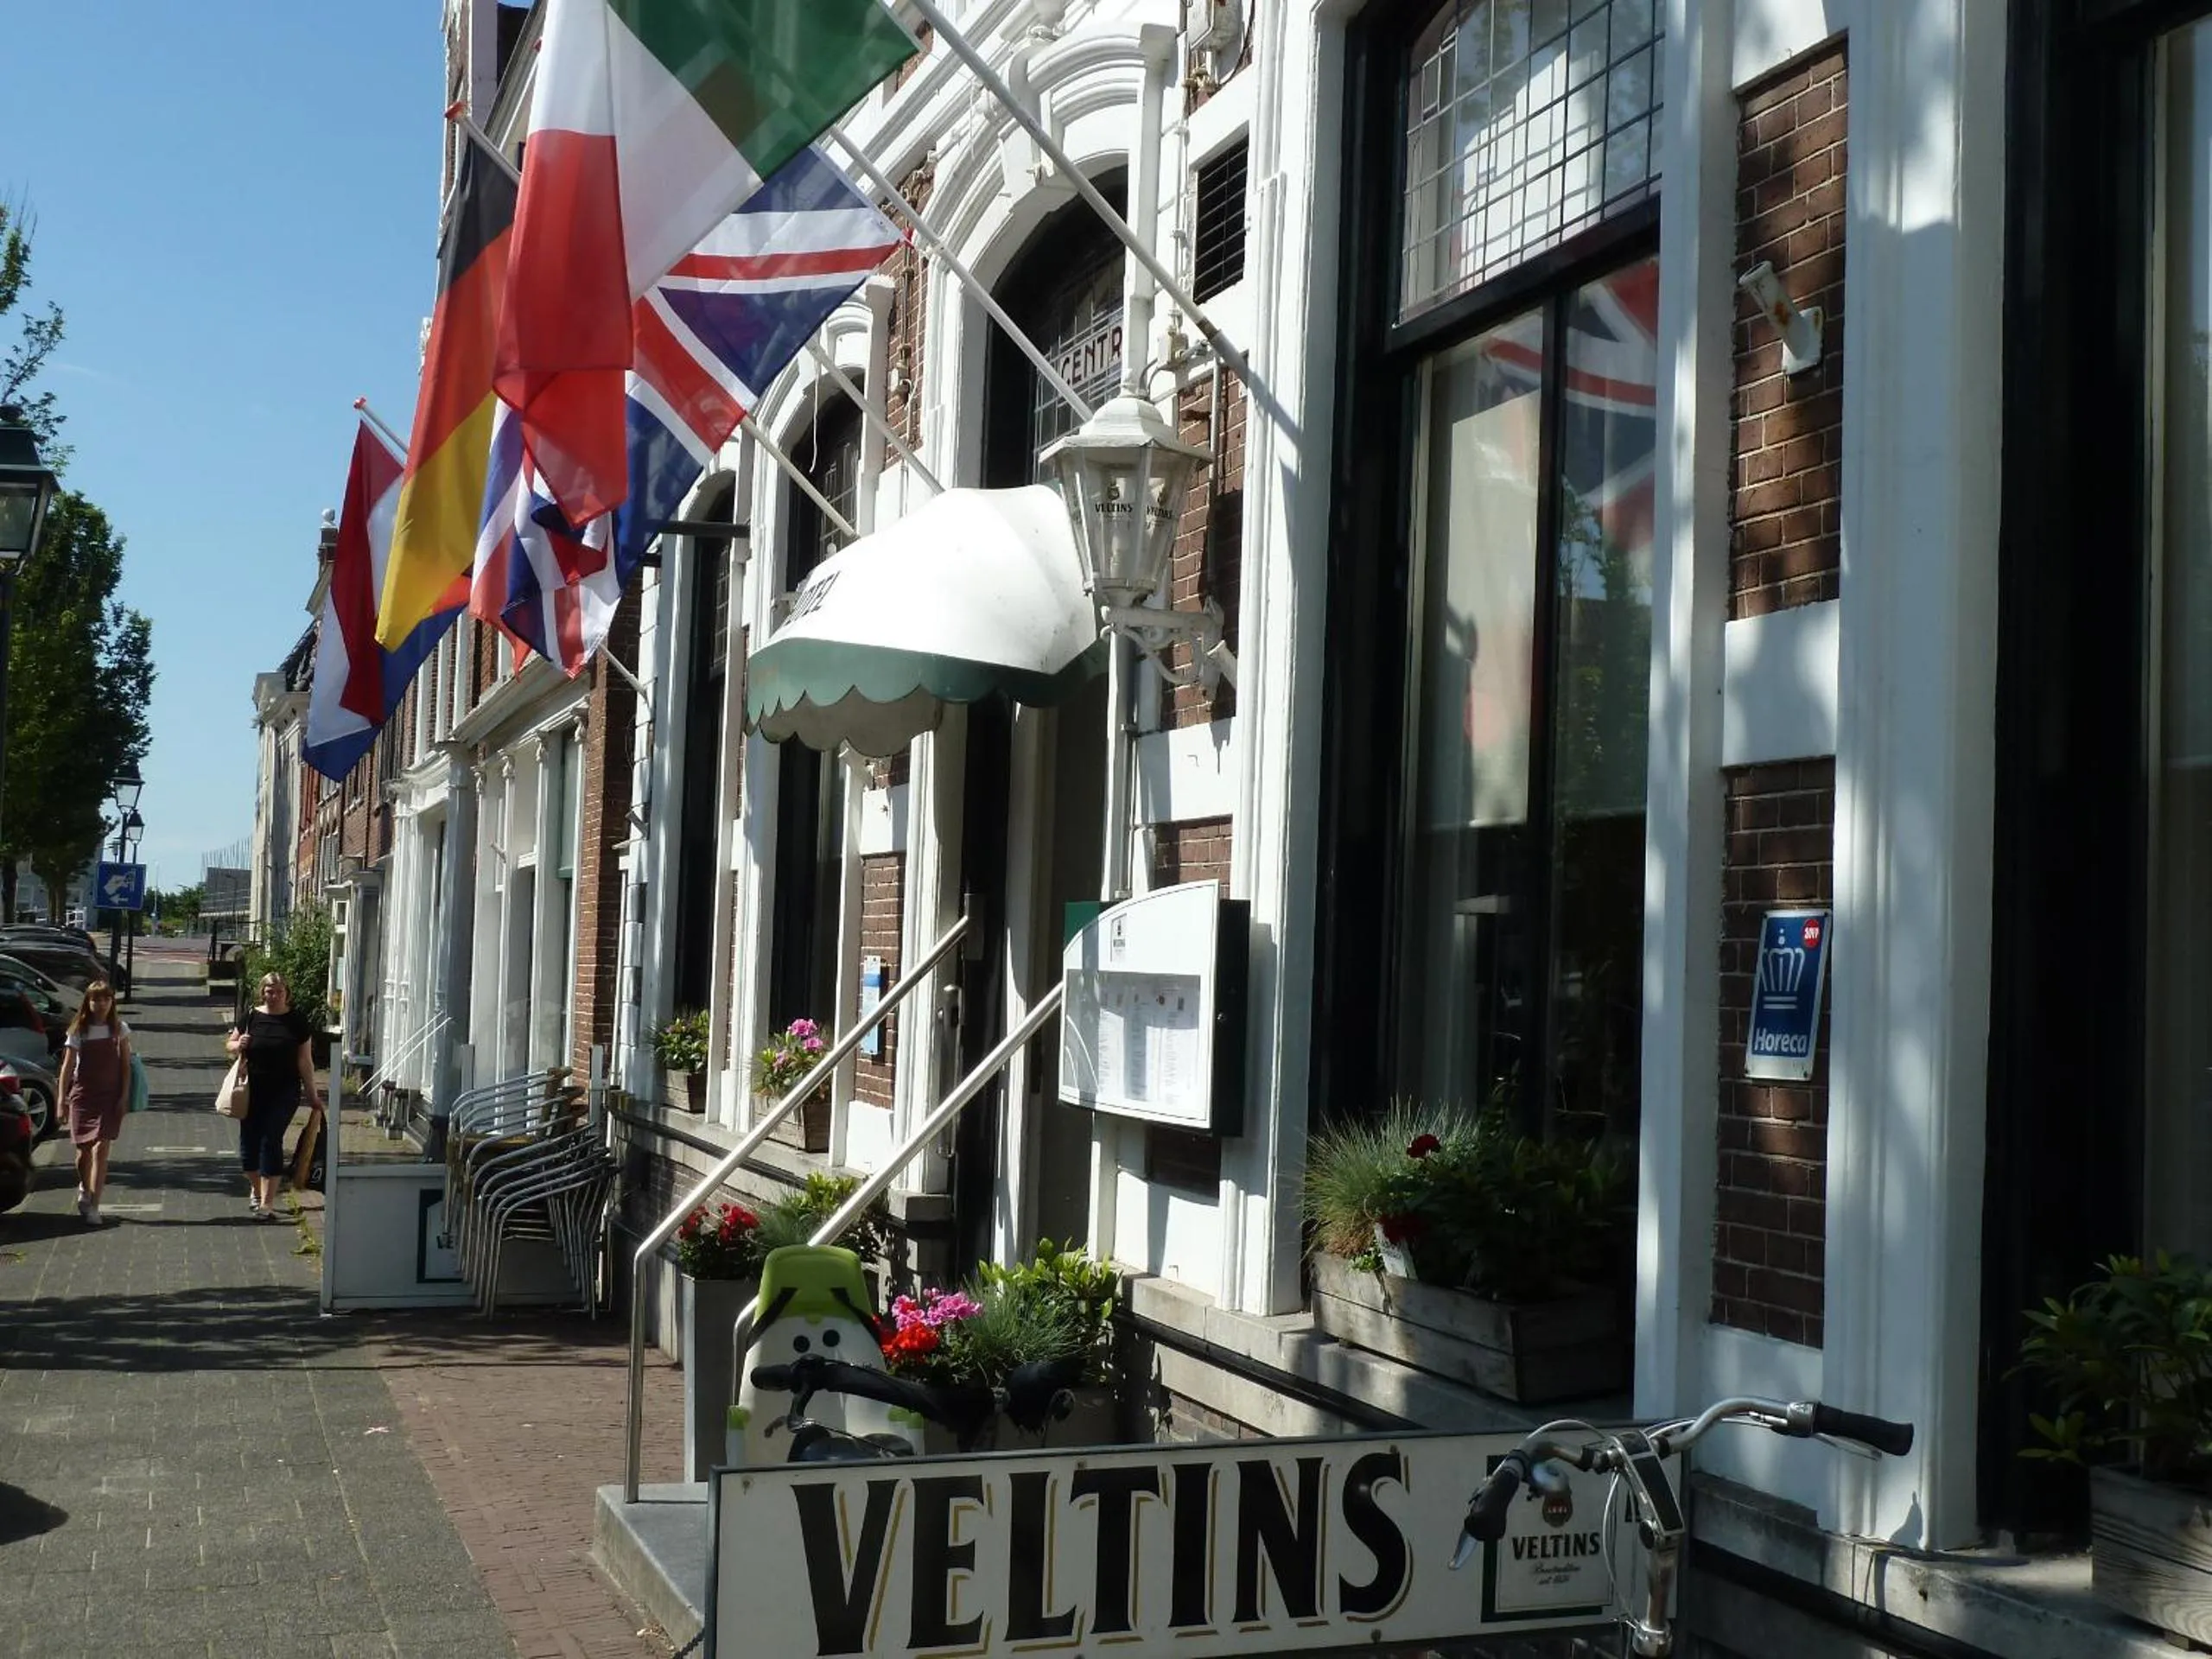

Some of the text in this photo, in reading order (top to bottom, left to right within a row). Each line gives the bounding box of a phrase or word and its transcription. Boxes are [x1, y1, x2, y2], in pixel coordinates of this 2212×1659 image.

[1754, 1027, 1808, 1053] Horeca
[791, 1452, 1411, 1657] VELTINS
[1511, 1532, 1601, 1560] VELTINS
